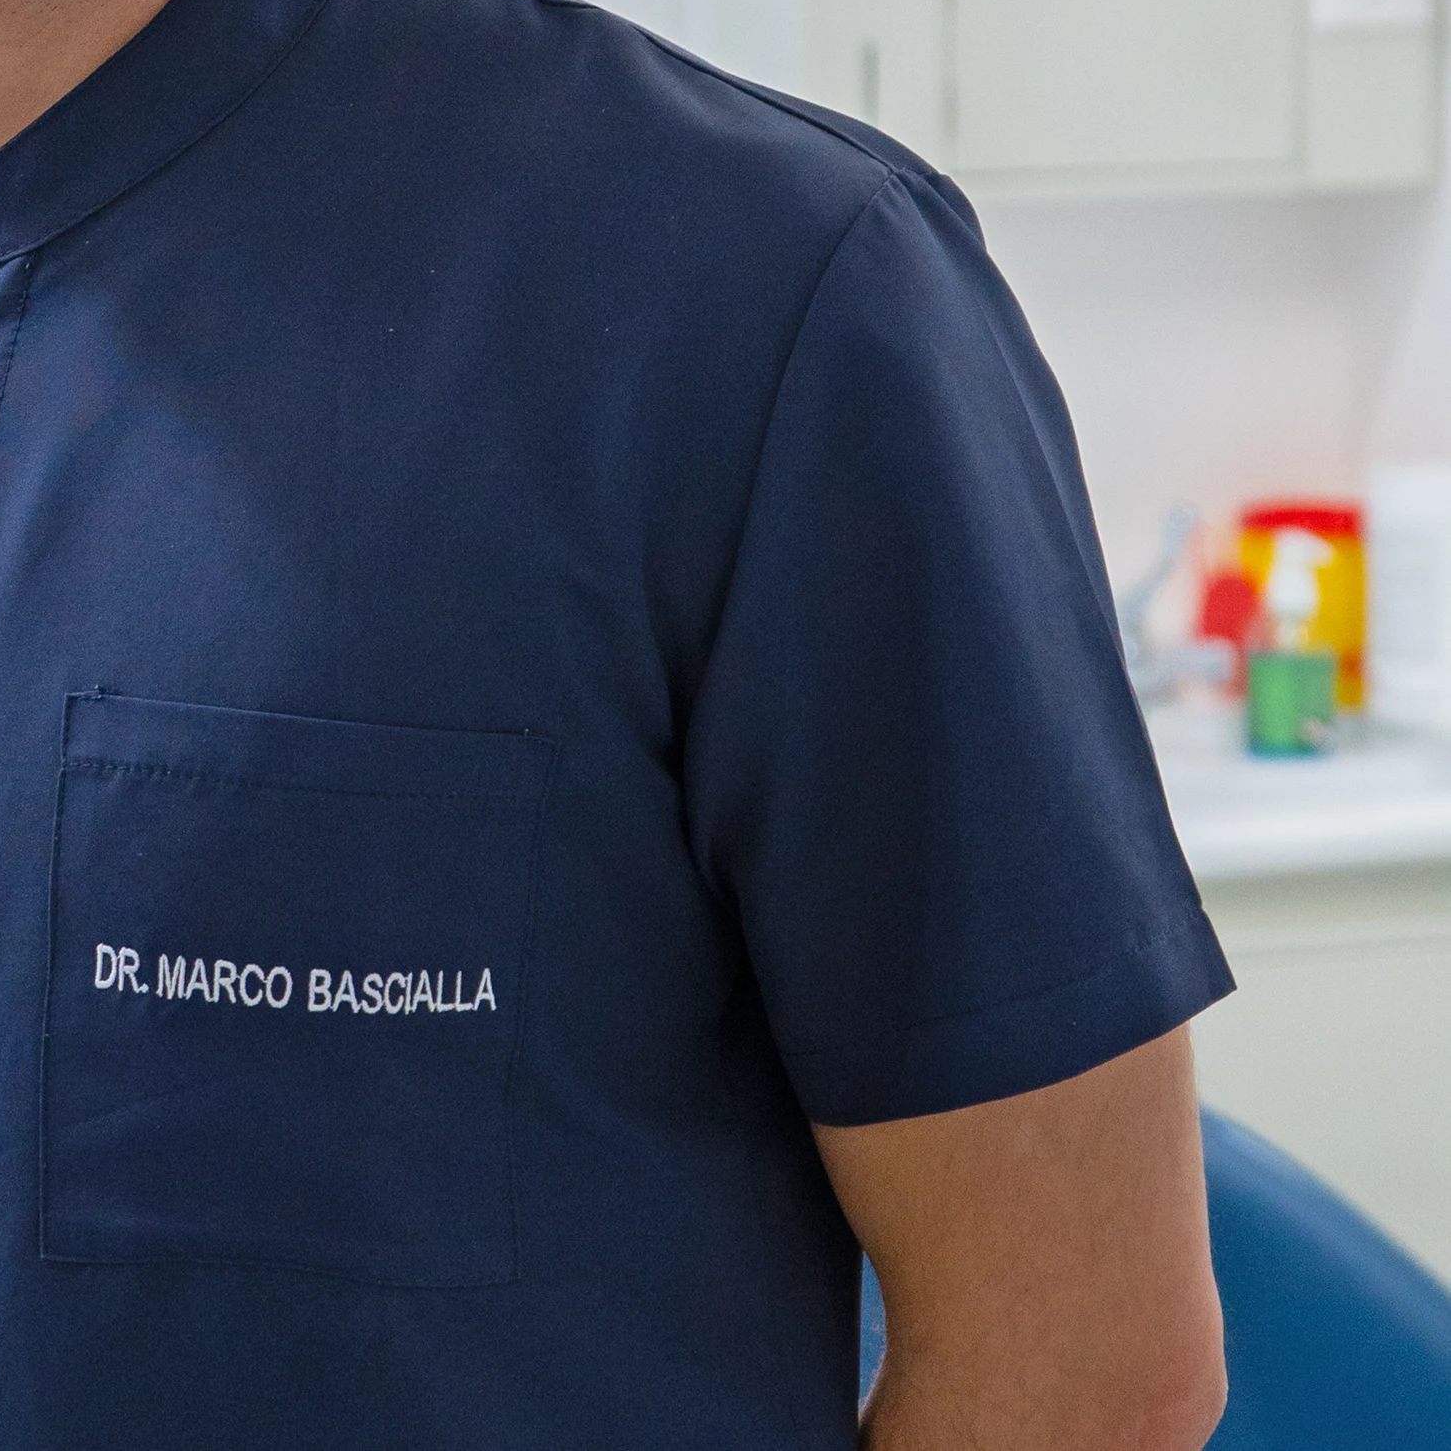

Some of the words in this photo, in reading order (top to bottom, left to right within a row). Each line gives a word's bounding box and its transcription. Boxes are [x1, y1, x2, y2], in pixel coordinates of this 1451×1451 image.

[93, 942, 149, 994] DR.
[155, 953, 293, 1008] MARCO
[307, 967, 497, 1015] BASCIALLA
